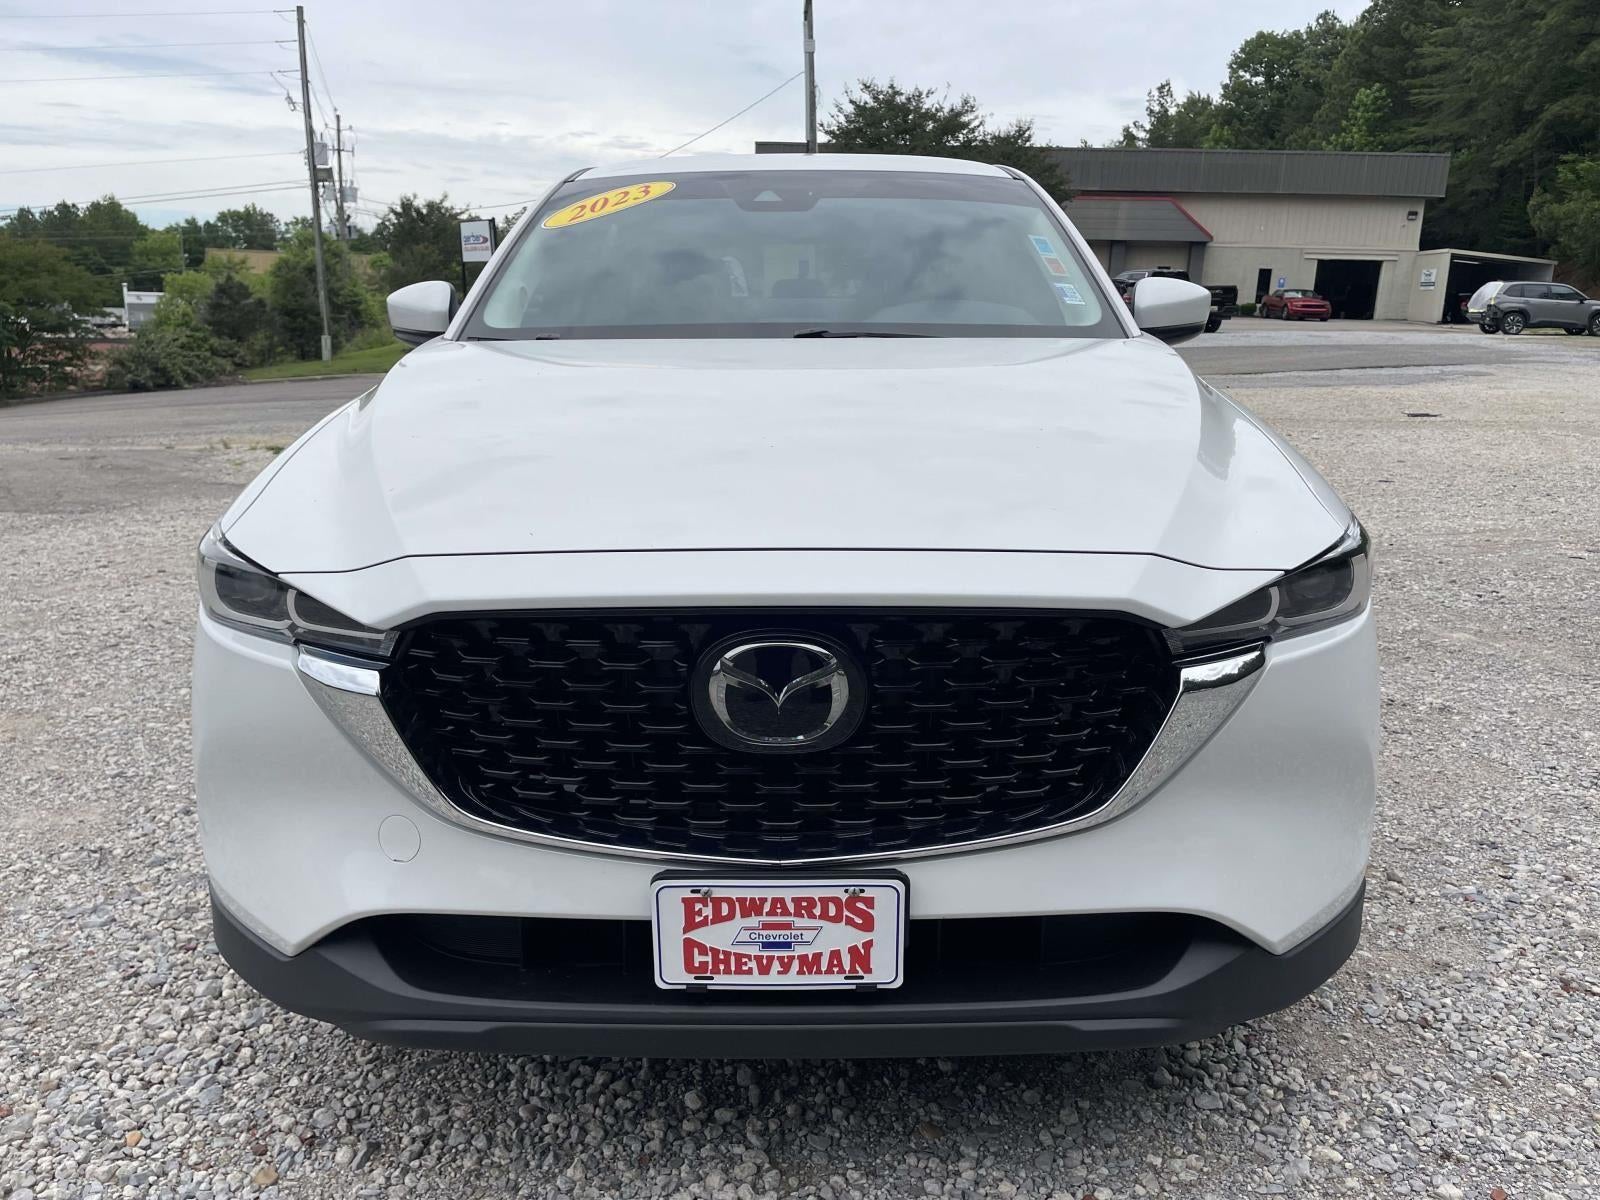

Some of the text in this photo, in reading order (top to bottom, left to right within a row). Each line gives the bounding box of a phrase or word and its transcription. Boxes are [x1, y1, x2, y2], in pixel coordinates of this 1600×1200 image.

[567, 184, 652, 223] 2023
[682, 896, 875, 935] EDWARDS
[682, 936, 874, 976] CHEVYMAN
[748, 931, 804, 942] Chevrolet
